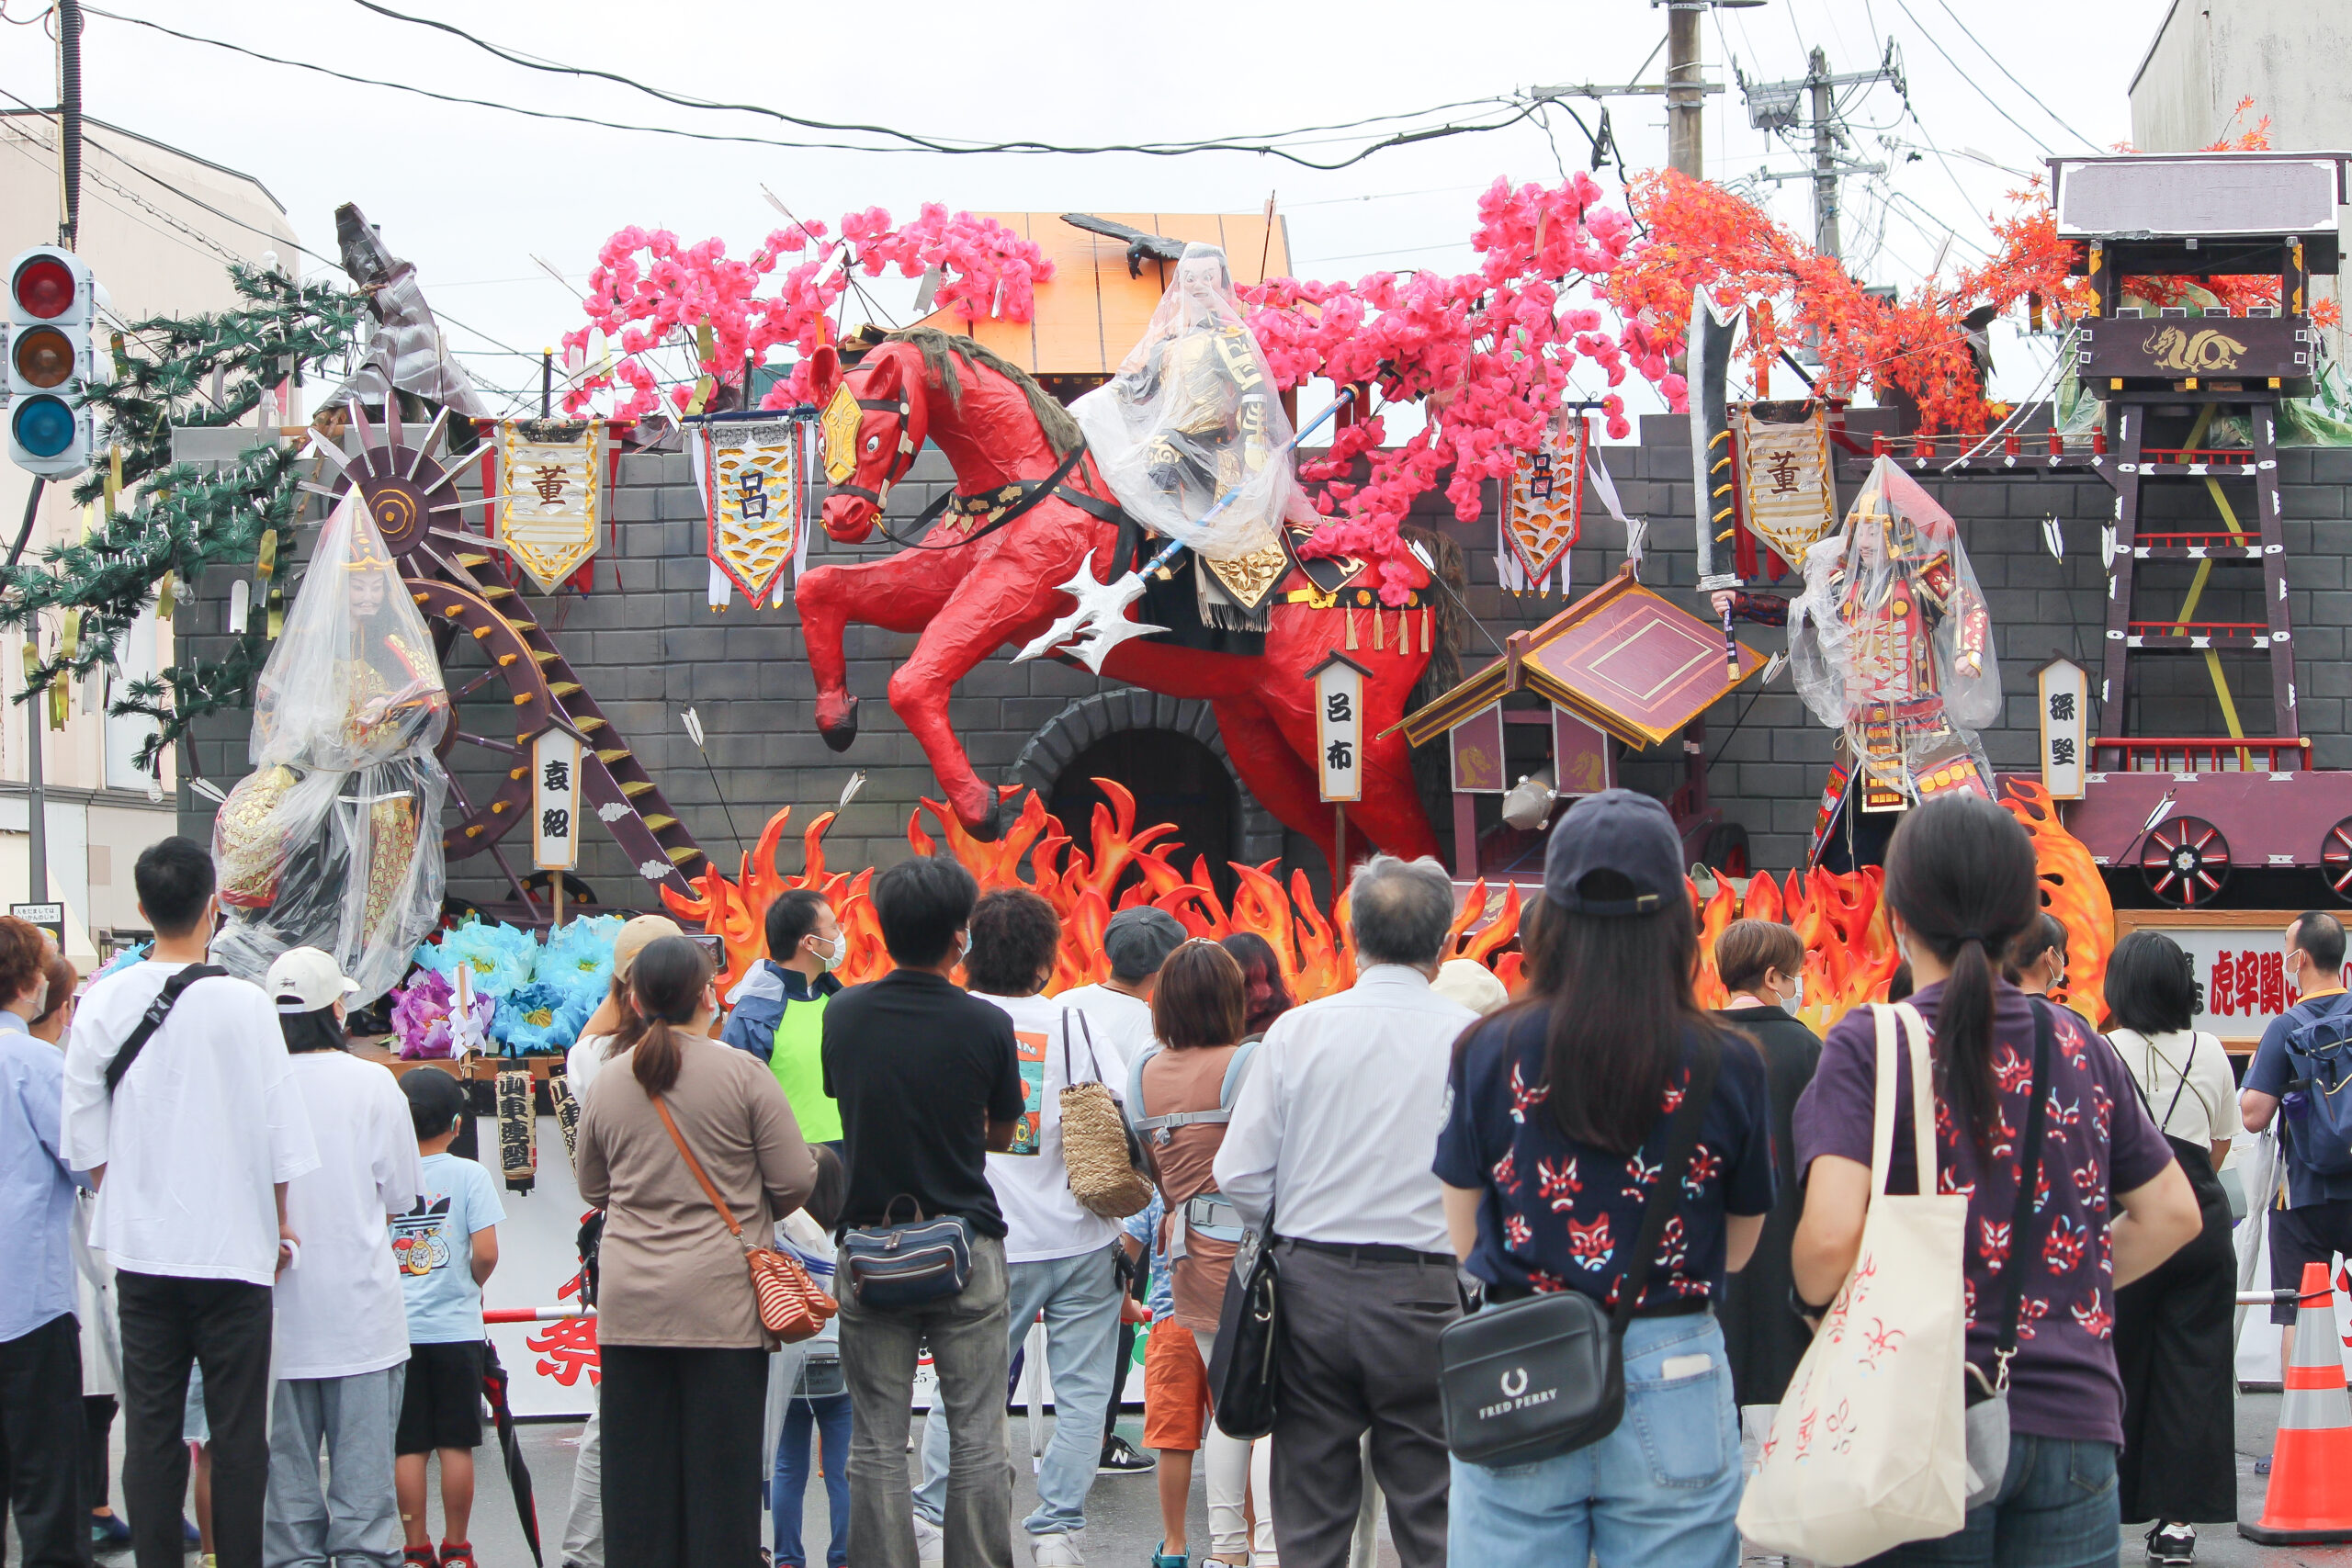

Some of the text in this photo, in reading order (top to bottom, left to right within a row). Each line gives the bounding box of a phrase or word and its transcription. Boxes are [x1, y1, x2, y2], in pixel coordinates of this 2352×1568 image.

[531, 465, 571, 506] 董
[1767, 450, 1801, 494] 董
[740, 472, 768, 520] 呂
[1327, 693, 1353, 770] 呂布
[1479, 1388, 1557, 1420] FRED PERRY
